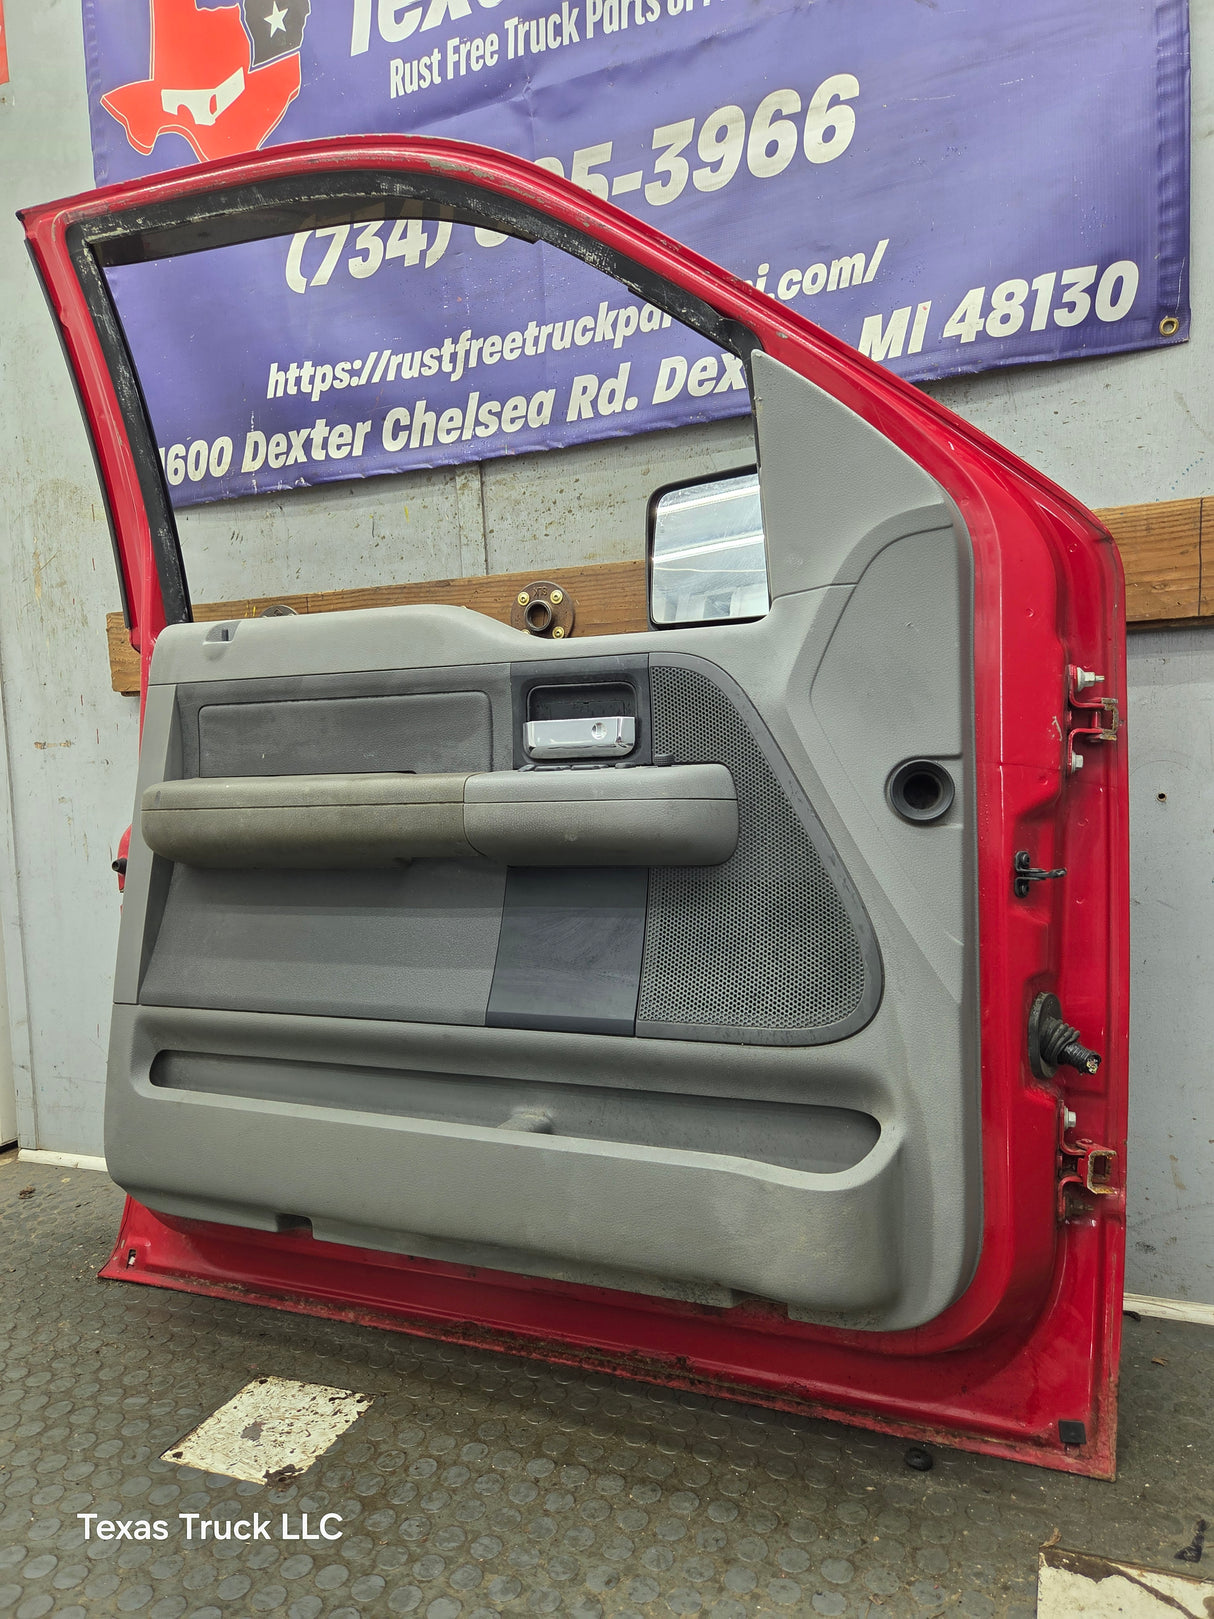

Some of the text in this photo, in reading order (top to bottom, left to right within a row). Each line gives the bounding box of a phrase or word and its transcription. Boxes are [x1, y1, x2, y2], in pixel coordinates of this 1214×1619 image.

[390, 48, 441, 99] Rust
[447, 33, 499, 80] Free
[504, 1, 580, 60] Truck
[586, 0, 661, 39] Parts
[285, 208, 453, 294] (734)
[158, 260, 1139, 486] 600 Dexter Chelsea Rd. Dex MI 48130
